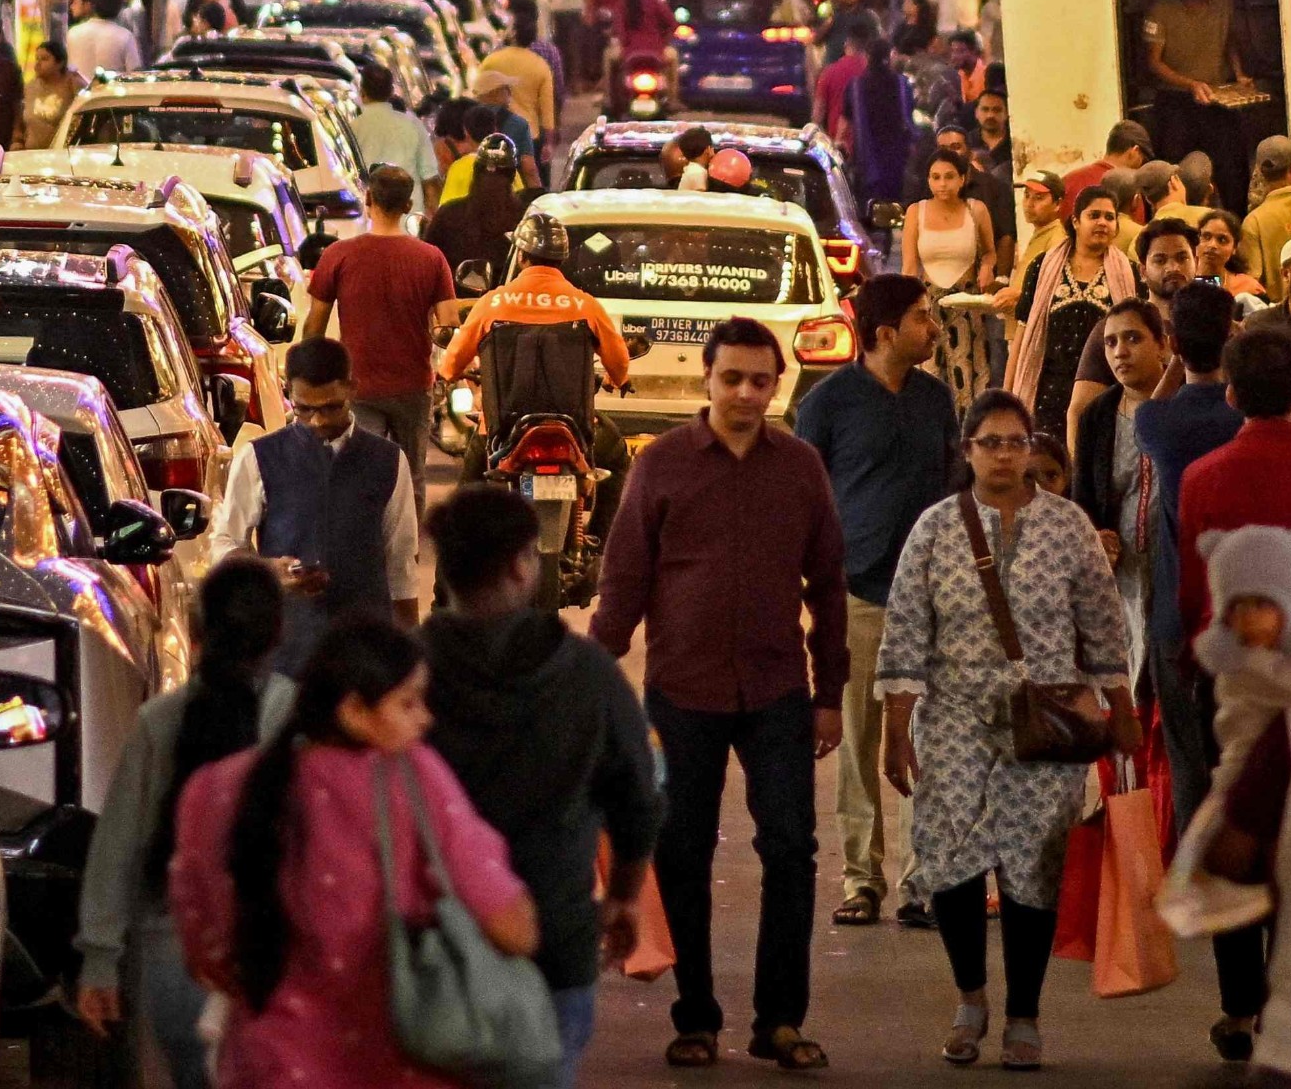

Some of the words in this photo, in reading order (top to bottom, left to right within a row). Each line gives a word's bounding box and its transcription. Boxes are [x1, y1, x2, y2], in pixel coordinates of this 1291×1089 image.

[604, 270, 639, 282] Uber
[644, 263, 703, 275] DRIVERS
[706, 265, 767, 279] WANTED
[490, 291, 585, 311] SWIGGY
[622, 323, 647, 333] Uber
[651, 317, 692, 330] DRIVER
[696, 320, 717, 331] WAN
[656, 330, 710, 343] 97368440
